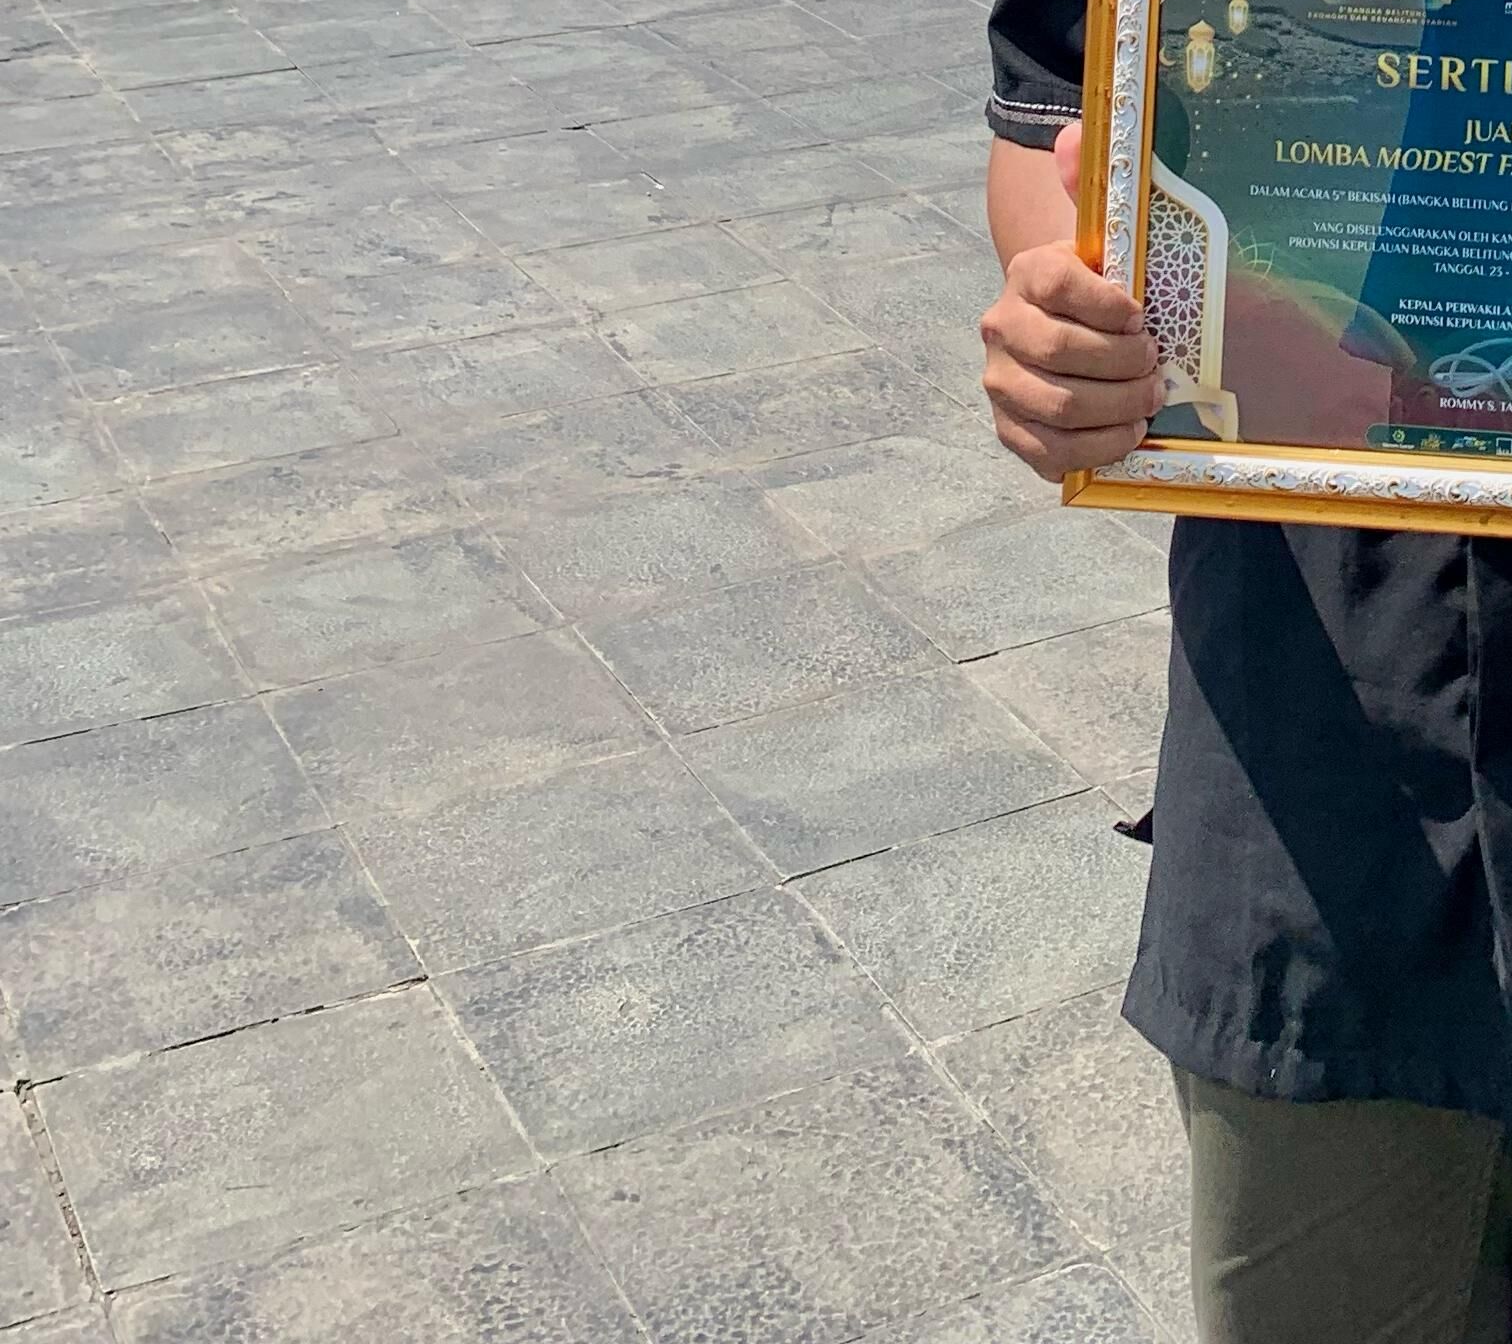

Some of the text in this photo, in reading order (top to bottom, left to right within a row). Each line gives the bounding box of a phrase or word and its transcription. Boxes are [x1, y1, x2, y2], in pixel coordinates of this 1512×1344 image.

[1274, 139, 1370, 169] LOMBA
[1375, 146, 1493, 176] MODEST
[1250, 184, 1290, 198] DALAM
[1292, 187, 1330, 201] ACARA
[1348, 191, 1396, 205] BEKISAH
[1398, 194, 1450, 209] (BANGKA
[1452, 197, 1508, 212] BELITUNG
[1313, 222, 1344, 234] YANG
[1346, 224, 1457, 241] DISELENGGARAKAN
[1458, 231, 1489, 243] OLEH
[1288, 236, 1340, 250] PROVINSI
[1342, 239, 1409, 255] KEPULAUAN
[1412, 244, 1460, 258] BANGKA
[1433, 262, 1487, 276] TANGGAL
[1489, 265, 1503, 277] 23
[1399, 299, 1443, 312] KEPALA
[1391, 313, 1444, 327] PROVINSI
[1440, 397, 1486, 411] ROMMY
